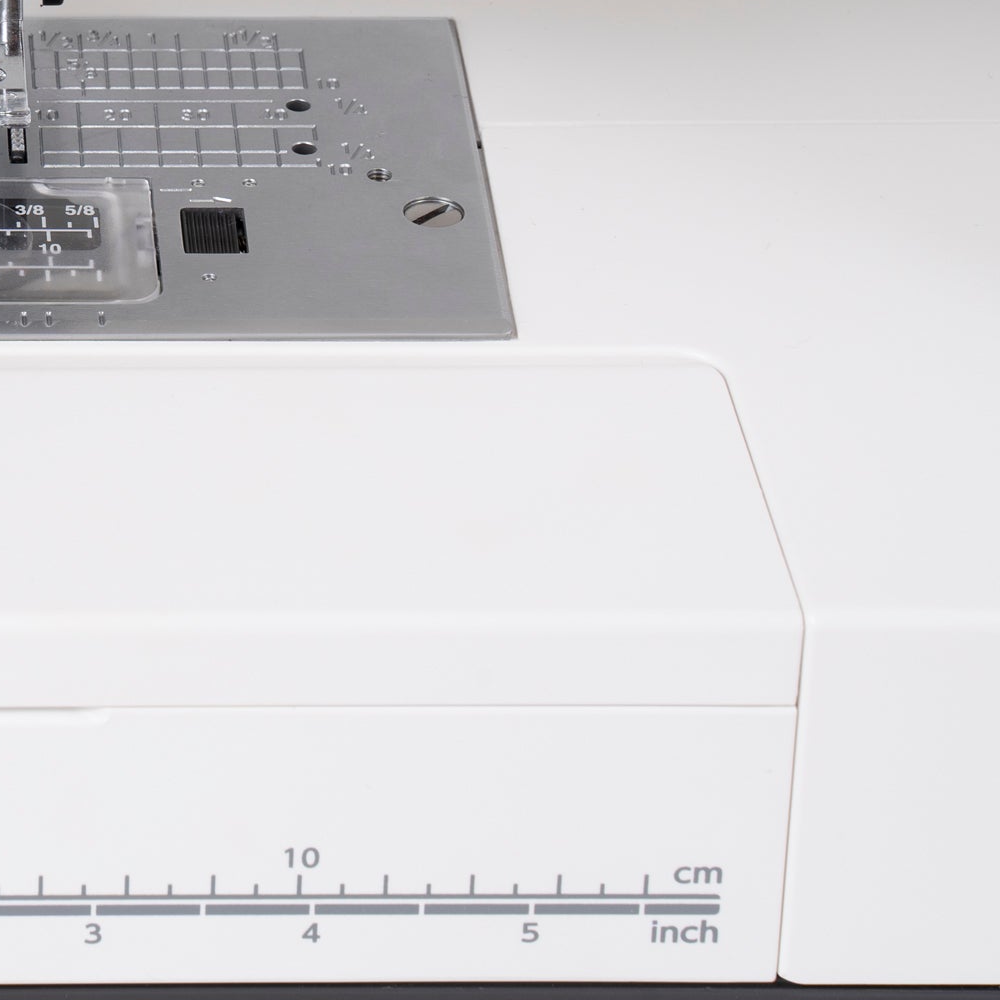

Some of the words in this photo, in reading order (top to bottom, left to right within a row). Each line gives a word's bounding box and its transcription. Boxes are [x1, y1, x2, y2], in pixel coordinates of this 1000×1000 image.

[103, 108, 132, 122] 20
[14, 204, 45, 216] 3/8
[64, 204, 96, 216] 5/8
[38, 243, 62, 255] 10
[284, 846, 321, 869] 10
[673, 864, 724, 885] cm
[83, 922, 103, 945] 3
[301, 922, 321, 944] 4
[521, 922, 540, 944] 5
[650, 919, 720, 944] inch
